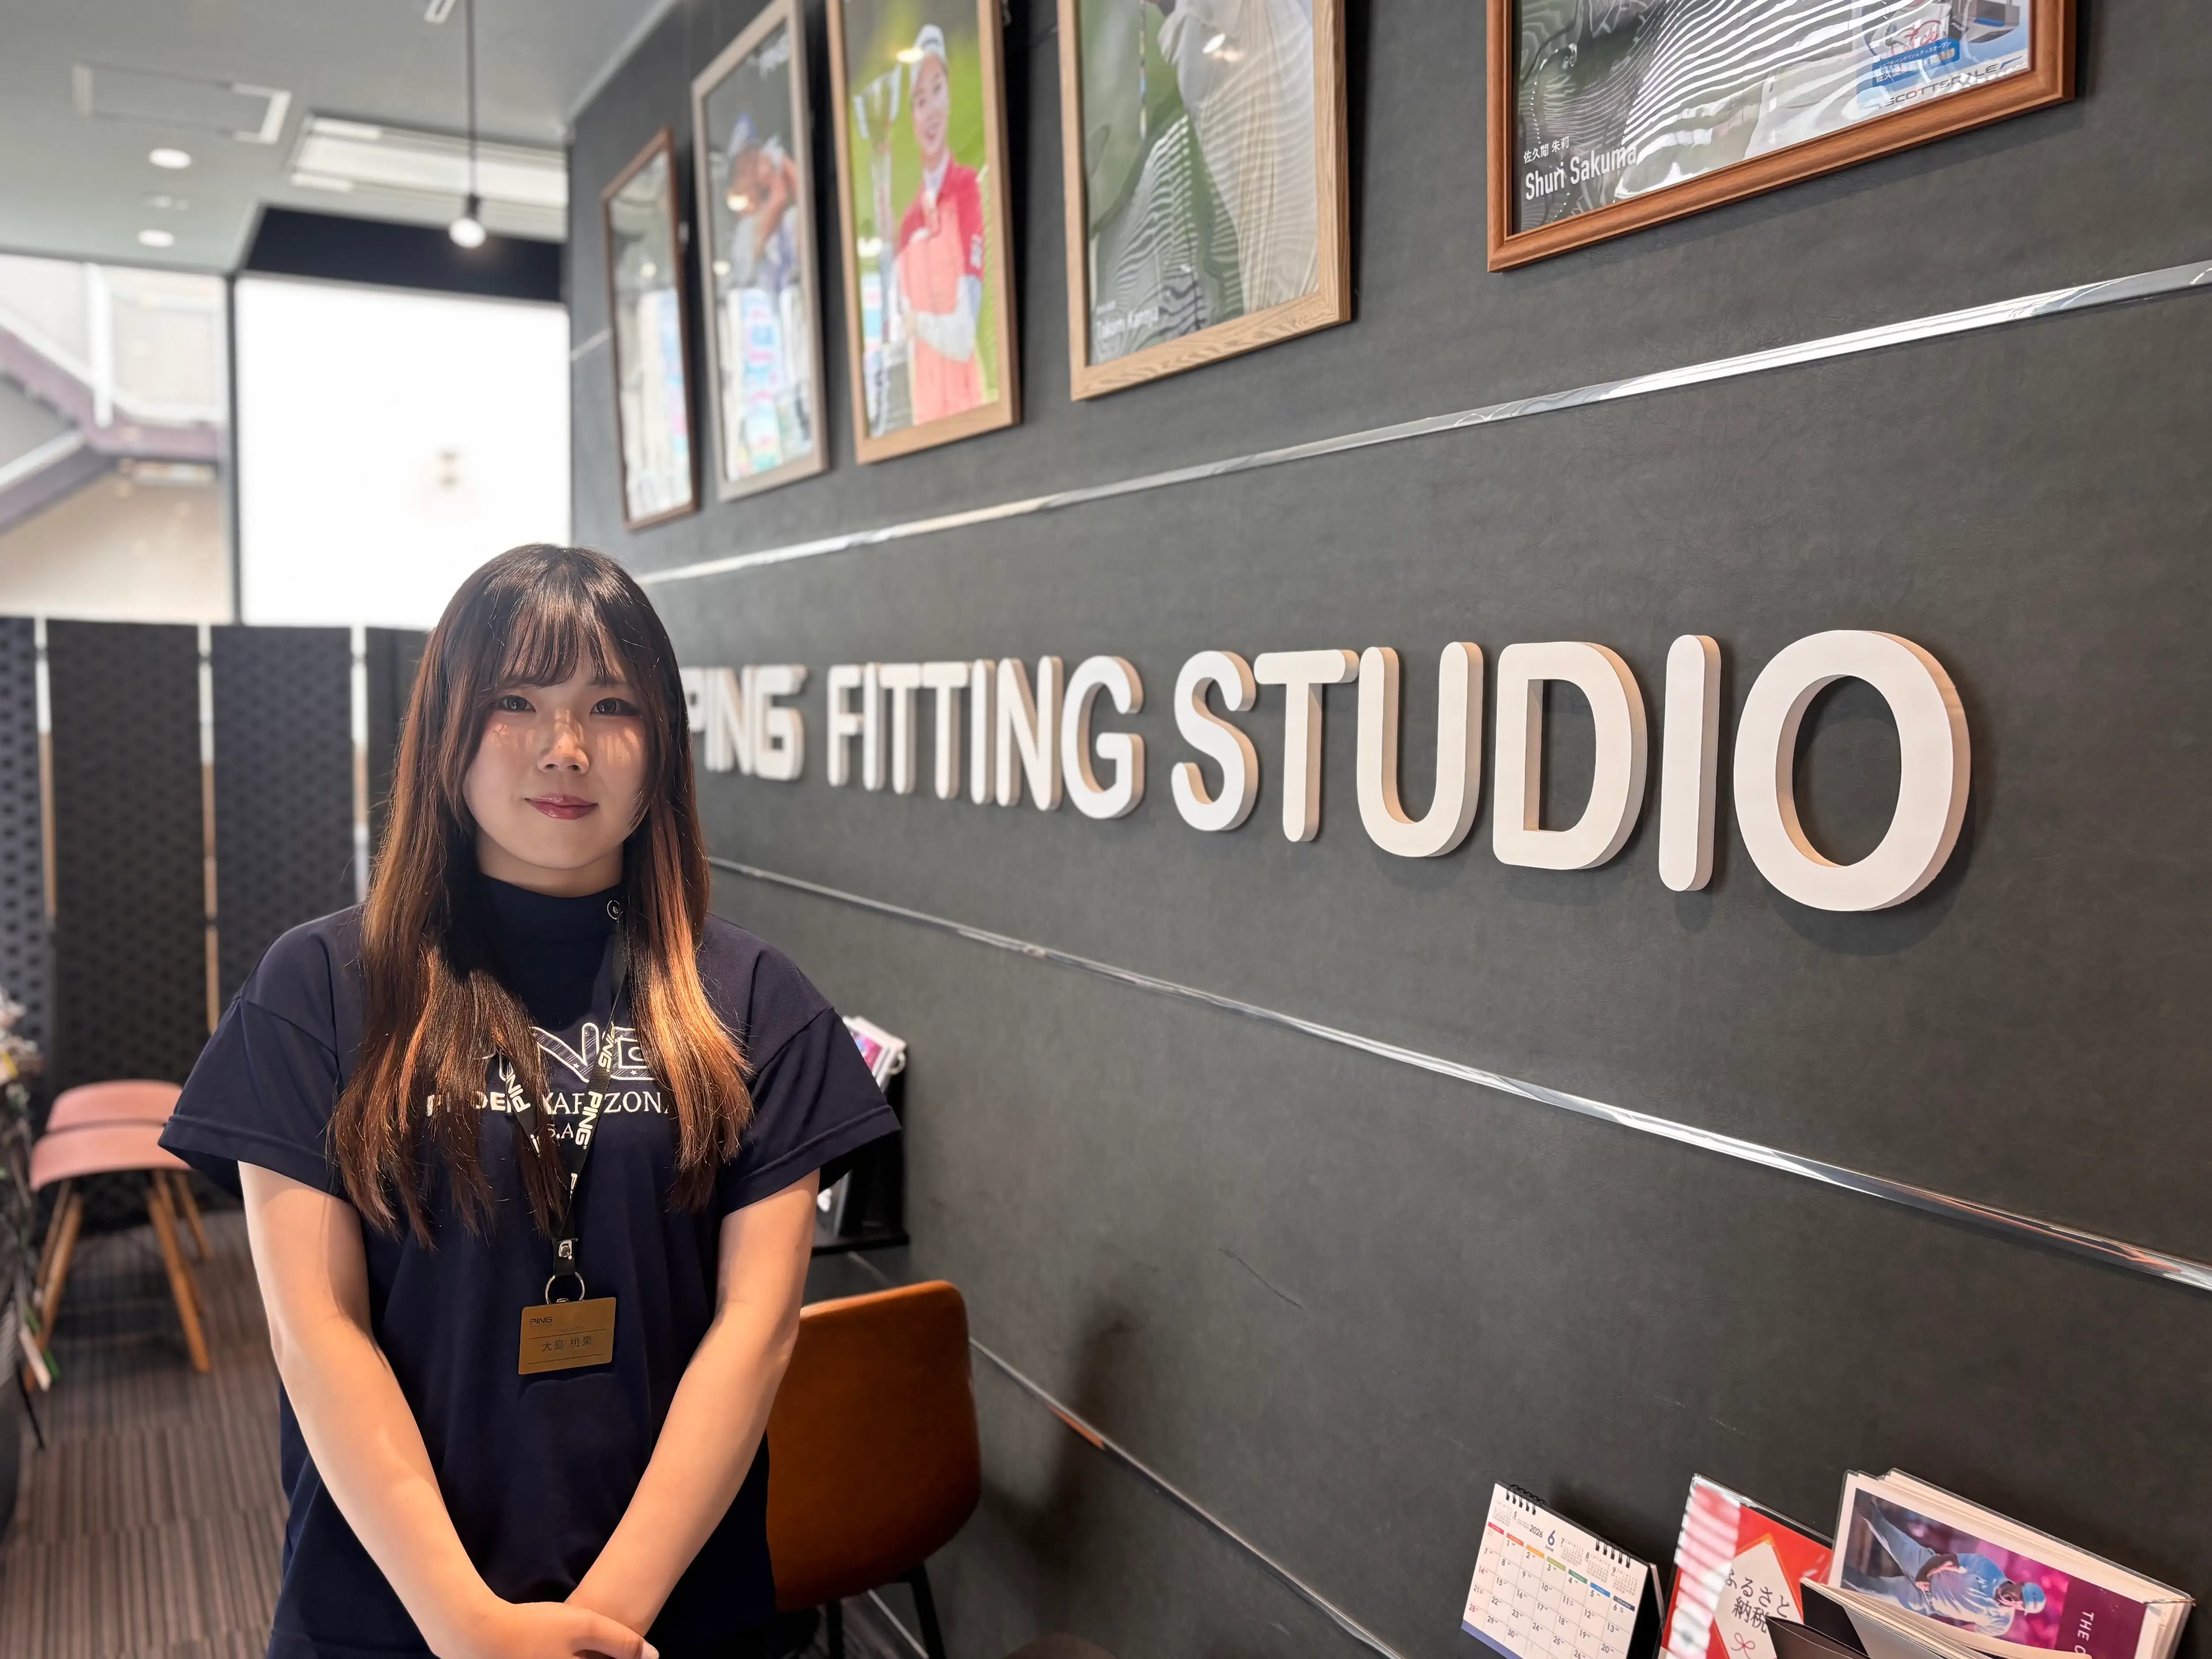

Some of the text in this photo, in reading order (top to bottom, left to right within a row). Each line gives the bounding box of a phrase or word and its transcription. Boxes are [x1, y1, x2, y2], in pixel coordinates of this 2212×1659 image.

[1523, 136, 1570, 164] 佐久間 朱莉
[1526, 147, 1637, 201] Shuri Sakuma
[827, 655, 1144, 819] FITTING
[1171, 630, 1971, 911] STUDIO
[575, 1091, 603, 1148] PING
[530, 1316, 553, 1326] PING
[1529, 1524, 1556, 1546] 2026 6
[1496, 1577, 1503, 1586] 15
[1517, 1590, 1523, 1599] 16
[1537, 1602, 1544, 1611] 17
[1558, 1616, 1565, 1625] 18
[1580, 1629, 1586, 1639] 19
[1601, 1644, 1610, 1654] 20
[1541, 1583, 1549, 1592] 10
[1563, 1596, 1569, 1605] 11
[1584, 1609, 1591, 1619] 12
[1607, 1623, 1615, 1632] 13
[1726, 1569, 1790, 1618] ふるさと
[1733, 1596, 1770, 1633] 納税
[1469, 1604, 1476, 1613] 28
[1487, 1616, 1494, 1624] 29
[1507, 1628, 1515, 1638] 30
[1473, 1585, 1480, 1593] 21
[1491, 1596, 1498, 1606] 22
[1511, 1609, 1519, 1618] 23
[1532, 1622, 1539, 1632] 24
[1553, 1636, 1561, 1645] 25
[1574, 1650, 1581, 1659] 26
[2077, 1611, 2094, 1641] THE
